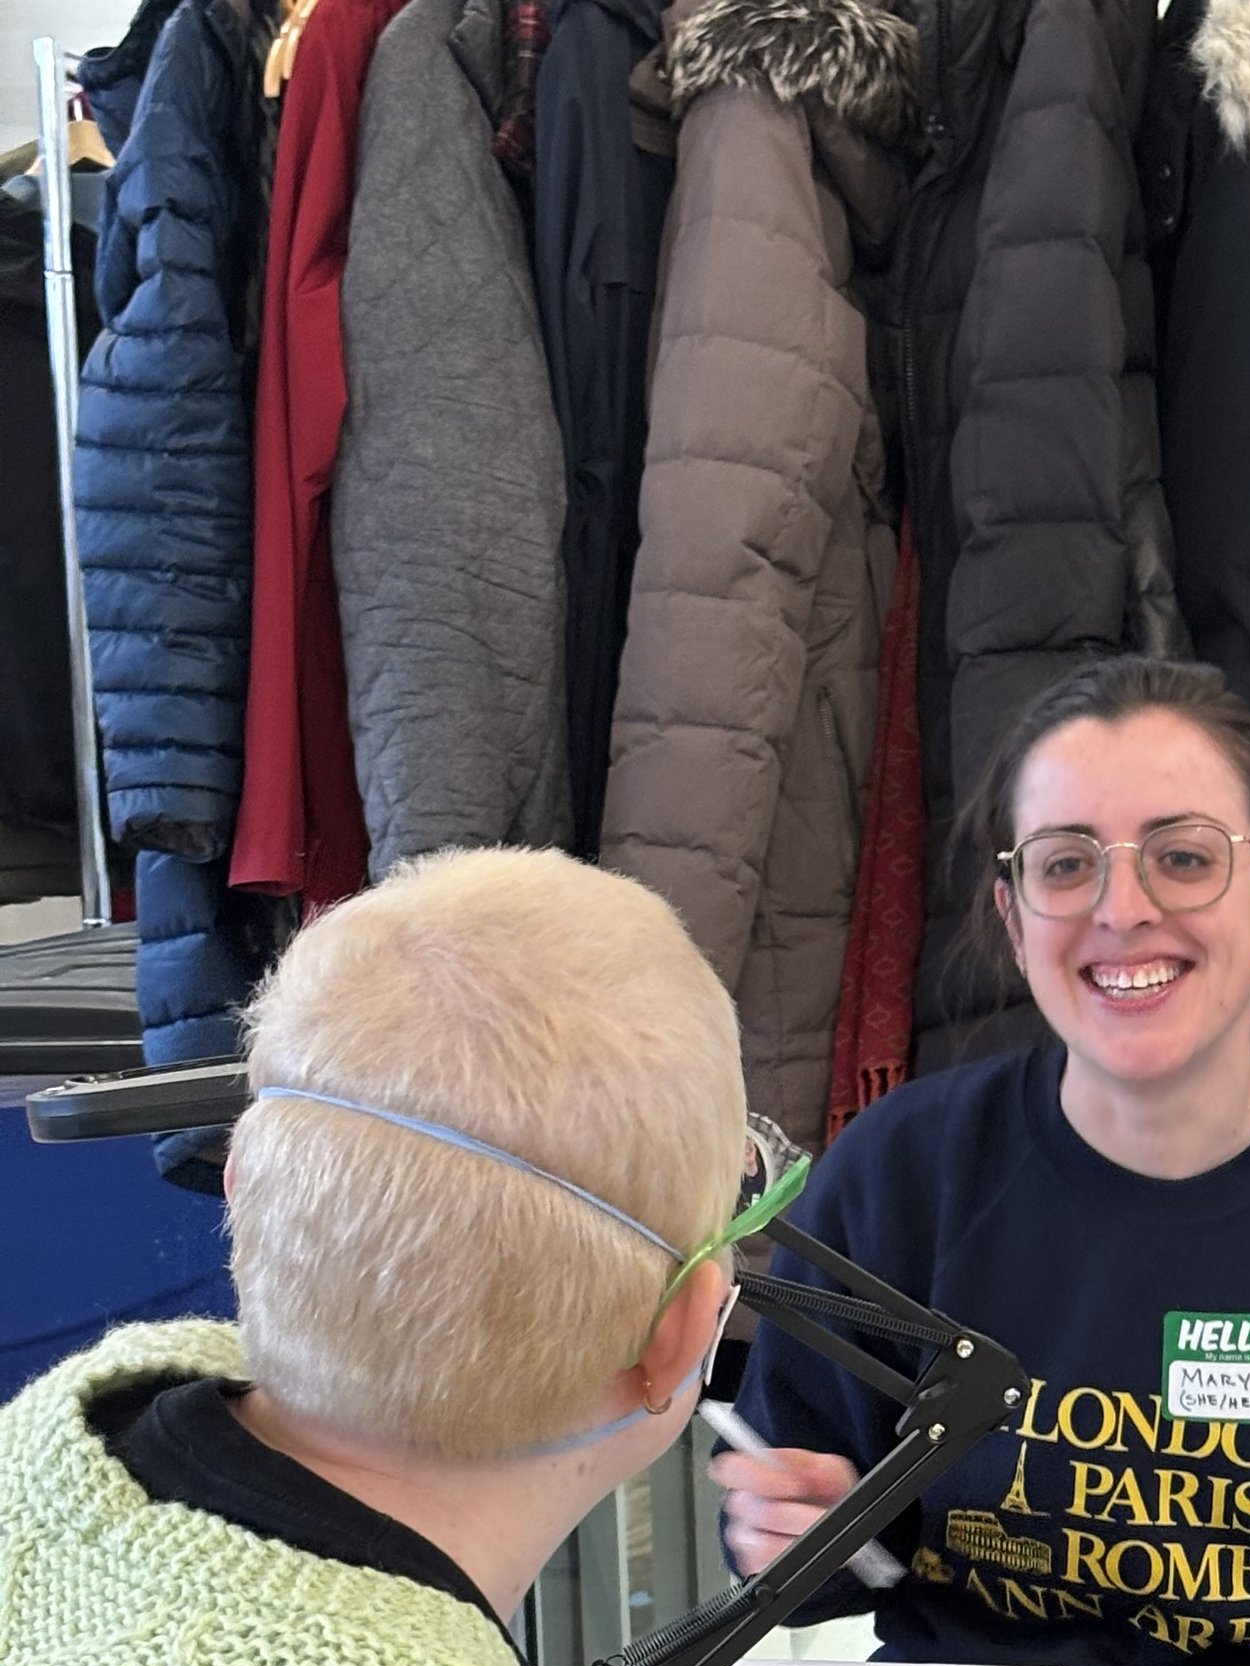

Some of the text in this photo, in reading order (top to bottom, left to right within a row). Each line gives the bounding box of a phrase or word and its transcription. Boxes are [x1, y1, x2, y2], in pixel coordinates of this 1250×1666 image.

[1205, 1352, 1250, 1361] My name is
[1181, 1368, 1250, 1391] MARY
